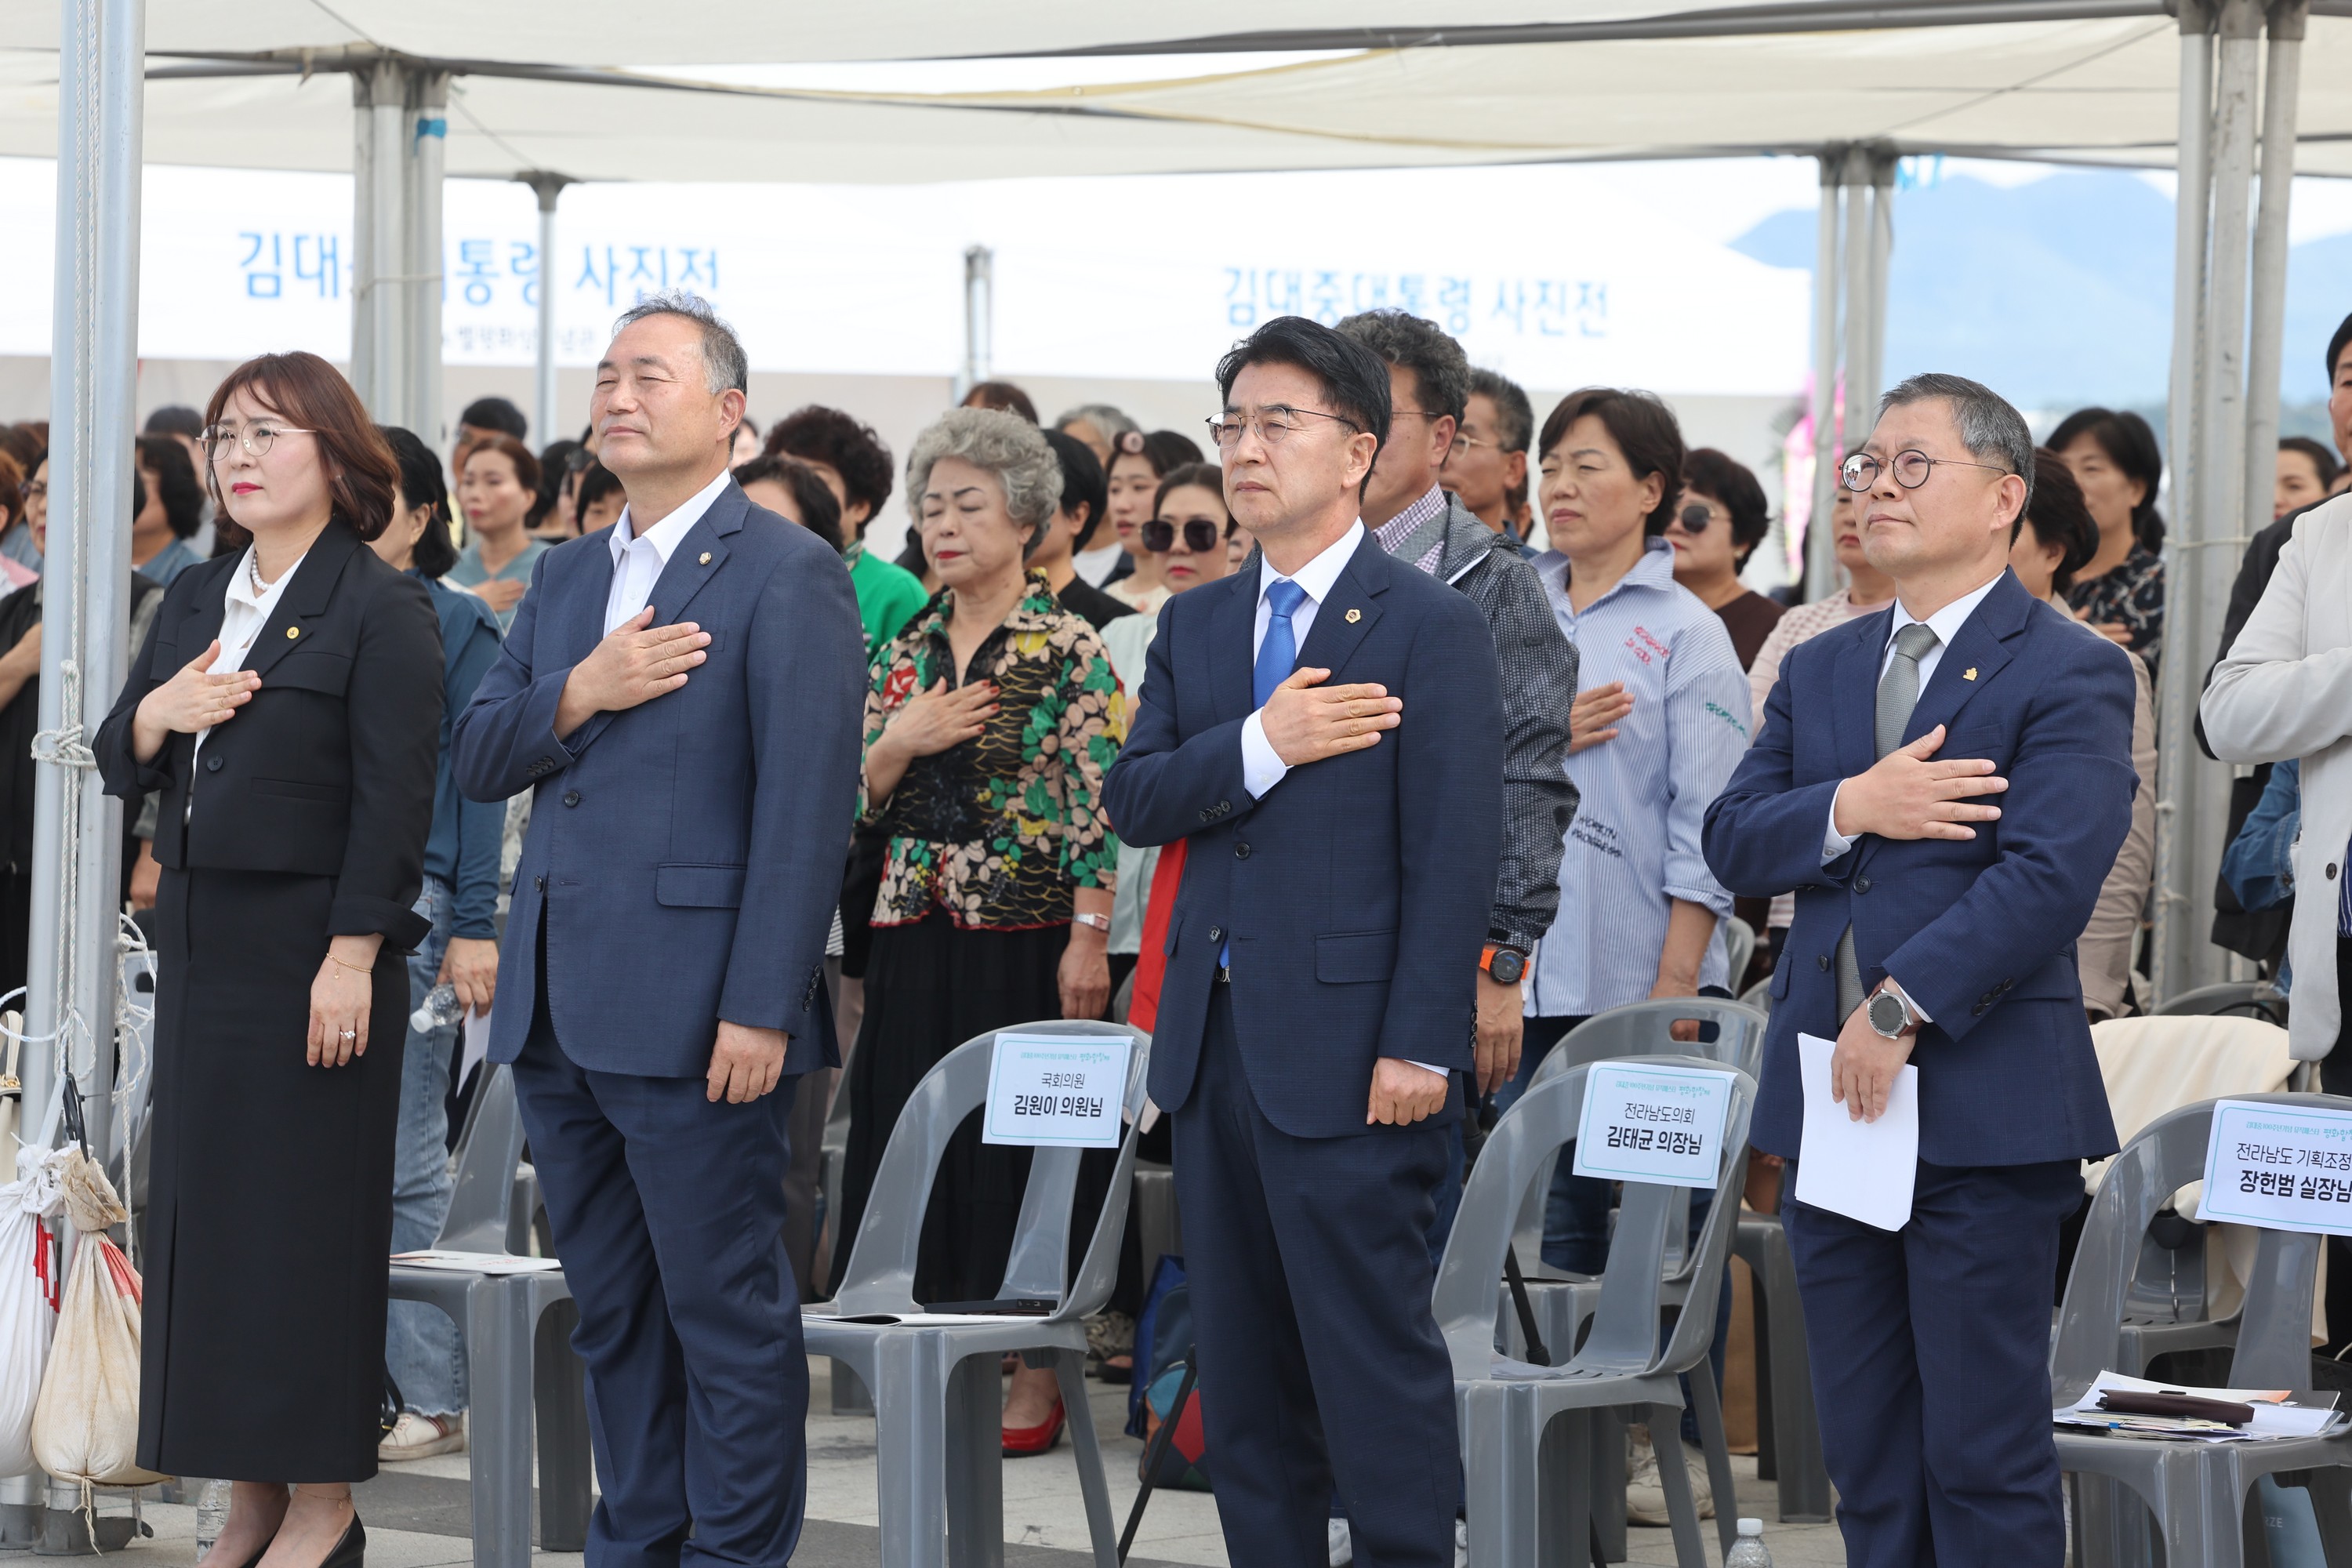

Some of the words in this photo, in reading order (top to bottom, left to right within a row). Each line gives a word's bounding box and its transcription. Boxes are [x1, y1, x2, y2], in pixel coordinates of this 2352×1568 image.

[1491, 278, 1610, 338] 사진전
[1041, 1072, 1086, 1089] 국회의원
[1014, 1094, 1058, 1116] 김원이
[1060, 1096, 1104, 1118] 의원님
[1624, 1102, 1697, 1125] 전라남도의회
[1606, 1125, 1654, 1151] 김태균
[1656, 1131, 1704, 1156] 의장님
[2236, 1142, 2294, 1165] 전라남도
[2296, 1149, 2352, 1171] 기획조정
[2240, 1169, 2296, 1198] 장헌범
[2300, 1175, 2352, 1203] 실장님
